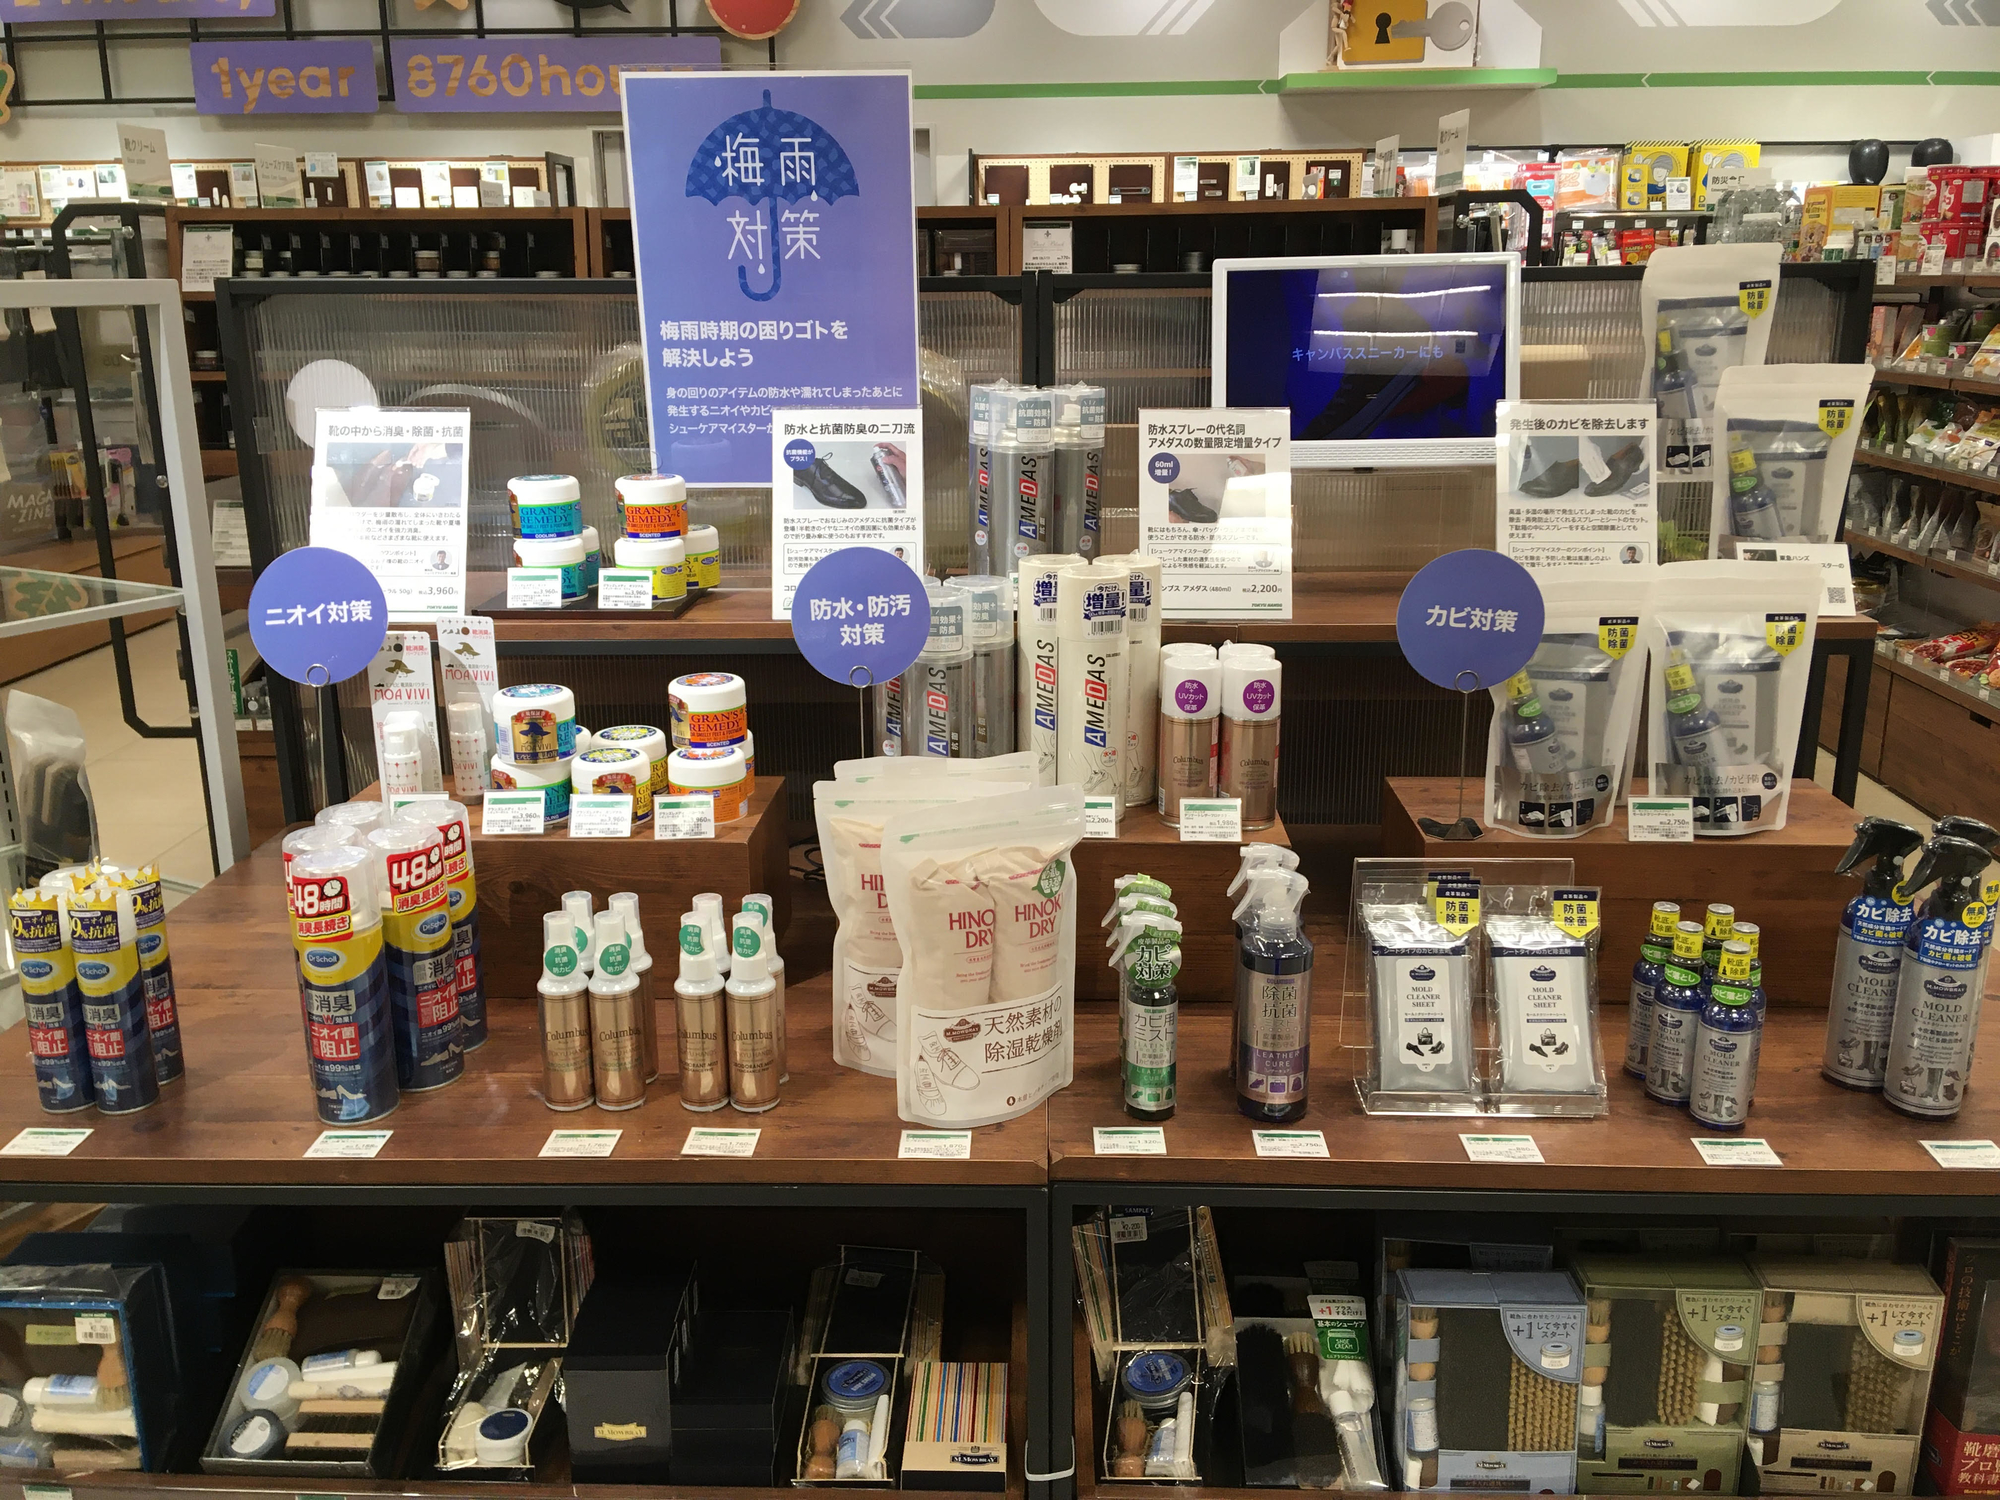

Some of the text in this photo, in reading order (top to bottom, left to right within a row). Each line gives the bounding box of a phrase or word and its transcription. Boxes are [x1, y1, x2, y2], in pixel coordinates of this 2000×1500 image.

[210, 55, 356, 112] 1year
[721, 133, 816, 187] 梅雨
[727, 210, 820, 260] 対策
[1747, 291, 1765, 300] 防菌
[1747, 301, 1763, 310] 除菌
[660, 320, 848, 341] 梅雨時期の困りゴトを
[662, 348, 753, 367] 解決しよう
[1292, 345, 1444, 362] キャンバススニーカーにも
[667, 387, 902, 398] 身の回りのアイテムの防水や濡れてしまったあとに
[1827, 410, 1846, 419] 防菌
[784, 423, 915, 435] 防水と抗菌防臭の二刀流
[1148, 424, 1245, 435] 防水スプレーの代名詞
[1510, 418, 1649, 430] 発生後のカビを除去します
[1826, 420, 1845, 429] 除菌
[329, 426, 463, 437] 靴の中から消臭・除菌・抗菌
[1148, 437, 1281, 449] アメダスの数量限定増量タイプ
[1155, 460, 1173, 468] 60ml
[1019, 456, 1039, 540] AMEDAS
[1084, 452, 1100, 531] AMEDAS
[521, 505, 566, 515] GRAN'S
[626, 506, 671, 515] GRAN'S
[520, 515, 570, 524] REMEDY
[626, 515, 673, 523] REMEDY
[1243, 585, 1282, 593] 税込2,200円
[1086, 592, 1126, 609] 増量!
[265, 600, 372, 626] ニオイ対策
[810, 595, 911, 621] 防水・防汚
[1426, 605, 1518, 633] カビ対策
[840, 623, 886, 647] 対策
[1608, 628, 1629, 637] 防菌
[1776, 625, 1796, 634] 防菌
[1608, 639, 1628, 649] 除菌
[1776, 636, 1795, 645] 除菌
[1035, 639, 1056, 731] AMEDAS
[1085, 653, 1107, 748] AMEDAS
[1247, 692, 1271, 700] UVカット
[691, 710, 739, 723] GRAN'S
[927, 667, 949, 756] AMEDAS
[690, 720, 740, 732] REMEDY
[1173, 756, 1203, 765] Columbus
[1240, 759, 1270, 767] Columbus
[444, 839, 463, 856] 時間
[390, 855, 443, 892] 48 時間
[294, 883, 343, 915] 48 時間
[396, 881, 447, 914] 消臭長続き
[1446, 901, 1469, 912] 防菌
[1563, 904, 1586, 915] 防菌
[1856, 903, 1912, 922] カビ除去
[1966, 904, 1985, 916] 無臭
[1446, 914, 1468, 924] 除菌
[298, 916, 350, 937] 消臭長続き
[1029, 916, 1057, 939] DRY
[965, 928, 996, 949] DRY
[1925, 924, 1982, 946] カビ除去
[1135, 945, 1170, 963] カビ
[1928, 950, 1972, 961] カビ菌を破壊
[1135, 962, 1172, 980] 対策
[1262, 985, 1297, 1001] 除菌
[1532, 986, 1554, 994] MOLD
[1925, 983, 1966, 993] M.MOWBRAY
[314, 992, 352, 1011] 消臭
[1712, 988, 1749, 1002] カビ落とし
[1922, 1000, 1963, 1012] MOLD
[33, 1006, 61, 1020] 消臭
[89, 1008, 117, 1021] 消臭
[984, 1001, 1062, 1037] 天然素材の
[1134, 1011, 1175, 1027] カビ用
[1911, 1008, 1968, 1023] CLEANER
[312, 1024, 355, 1039] ニオイ菌
[546, 1027, 589, 1042] Columbus
[599, 1027, 641, 1042] Columbus
[1134, 1028, 1174, 1042] ミスト
[38, 1041, 67, 1054] 阻止
[93, 1043, 124, 1056] 阻止
[320, 1040, 358, 1057] 阻止
[984, 1027, 1064, 1063] 除湿乾燥剤
[1256, 1050, 1301, 1059] LEATHER
[1703, 1054, 1741, 1067] CLEANER
[1709, 1050, 1735, 1060] MOLD
[1265, 1060, 1290, 1068] CURE
[1125, 1207, 1150, 1215] SAMPLE
[1319, 1306, 1333, 1315] +1
[1687, 1306, 1709, 1323] +1
[1711, 1305, 1750, 1314] して今すぐ
[1891, 1310, 1933, 1320] して今すぐ
[1509, 1313, 1577, 1321] 靴色に合わせたクリームを
[1716, 1314, 1745, 1322] スタート
[1866, 1311, 1888, 1328] +1
[1896, 1319, 1925, 1328] スタート
[1317, 1320, 1365, 1329] 基本のシューケア
[1513, 1322, 1533, 1340] +1
[1536, 1322, 1576, 1330] して今すぐ
[1541, 1330, 1571, 1339] スタート
